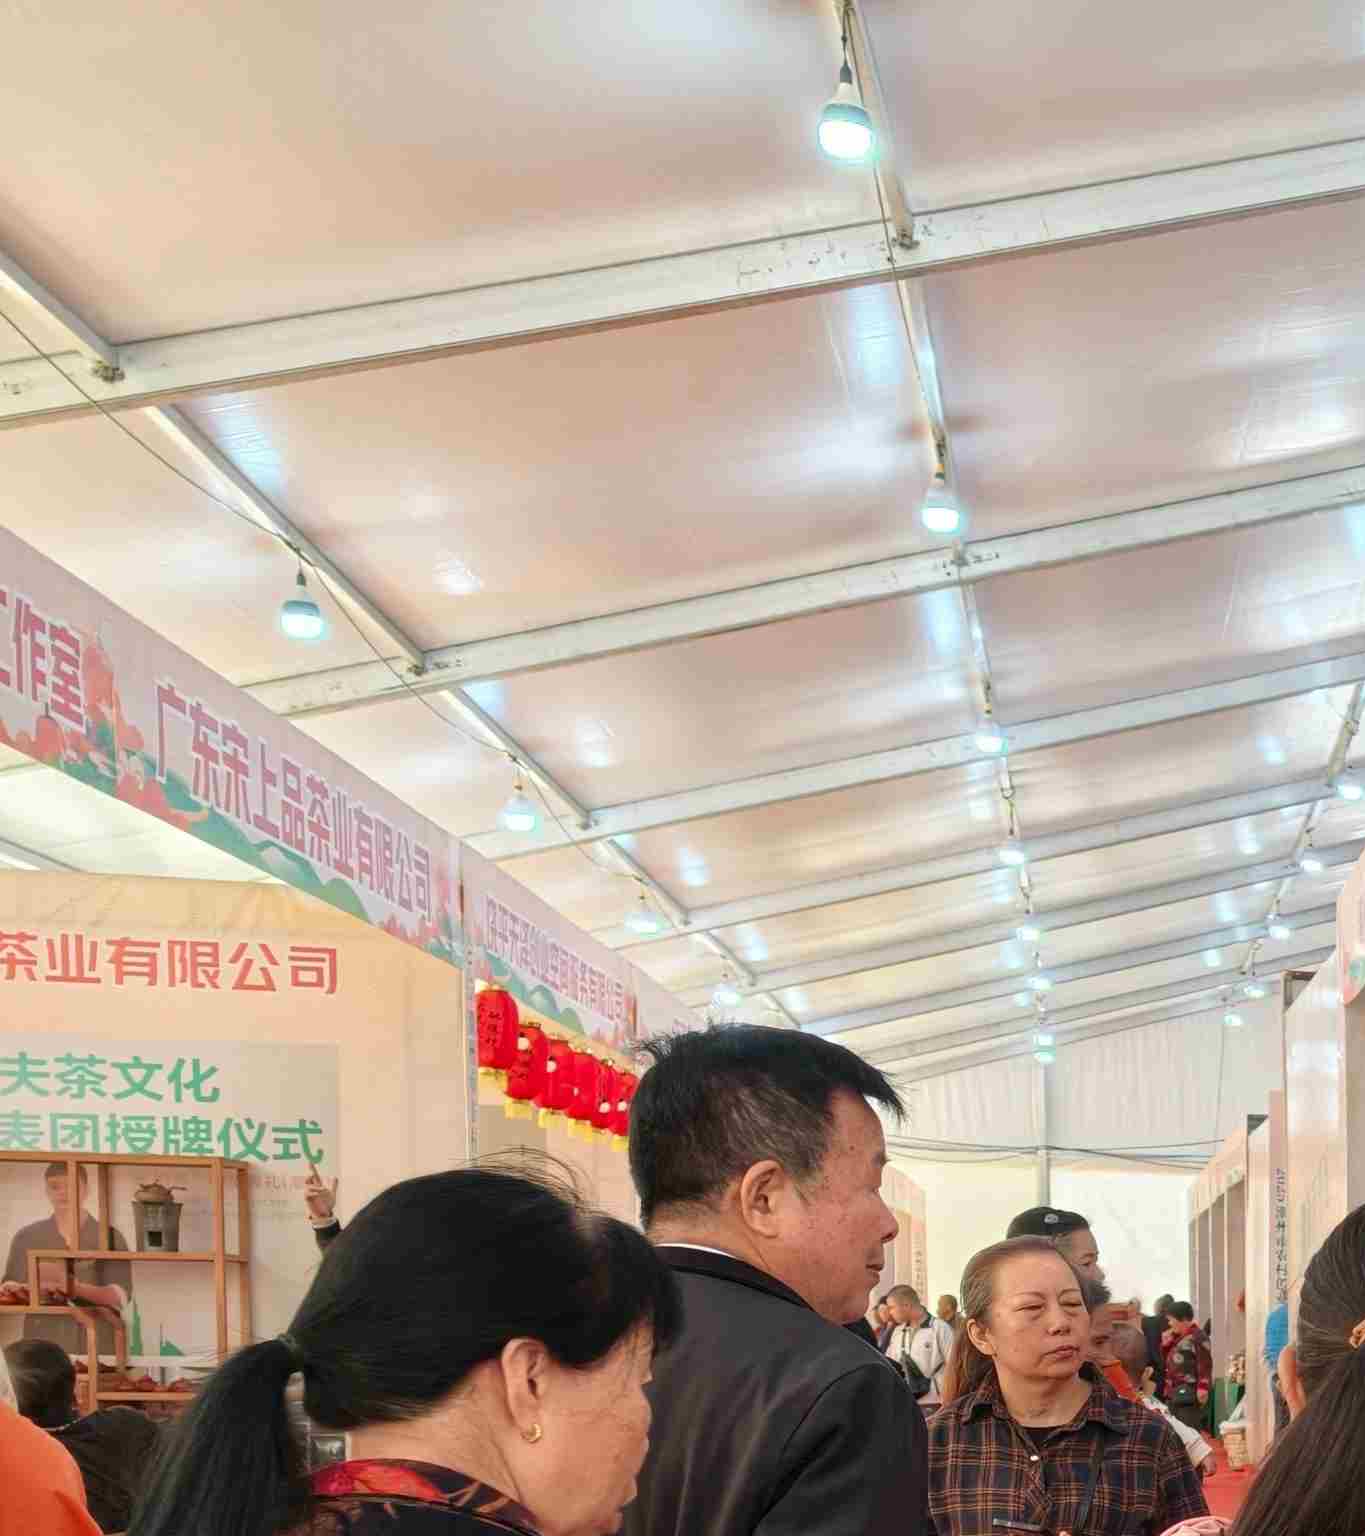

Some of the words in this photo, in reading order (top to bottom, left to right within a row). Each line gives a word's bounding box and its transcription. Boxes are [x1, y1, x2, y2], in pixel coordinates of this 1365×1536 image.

[157, 684, 431, 920] 广东宋上品茶业有限公司
[0, 931, 337, 994] 茶业有限公司
[0, 1051, 220, 1103] 夫茶文化
